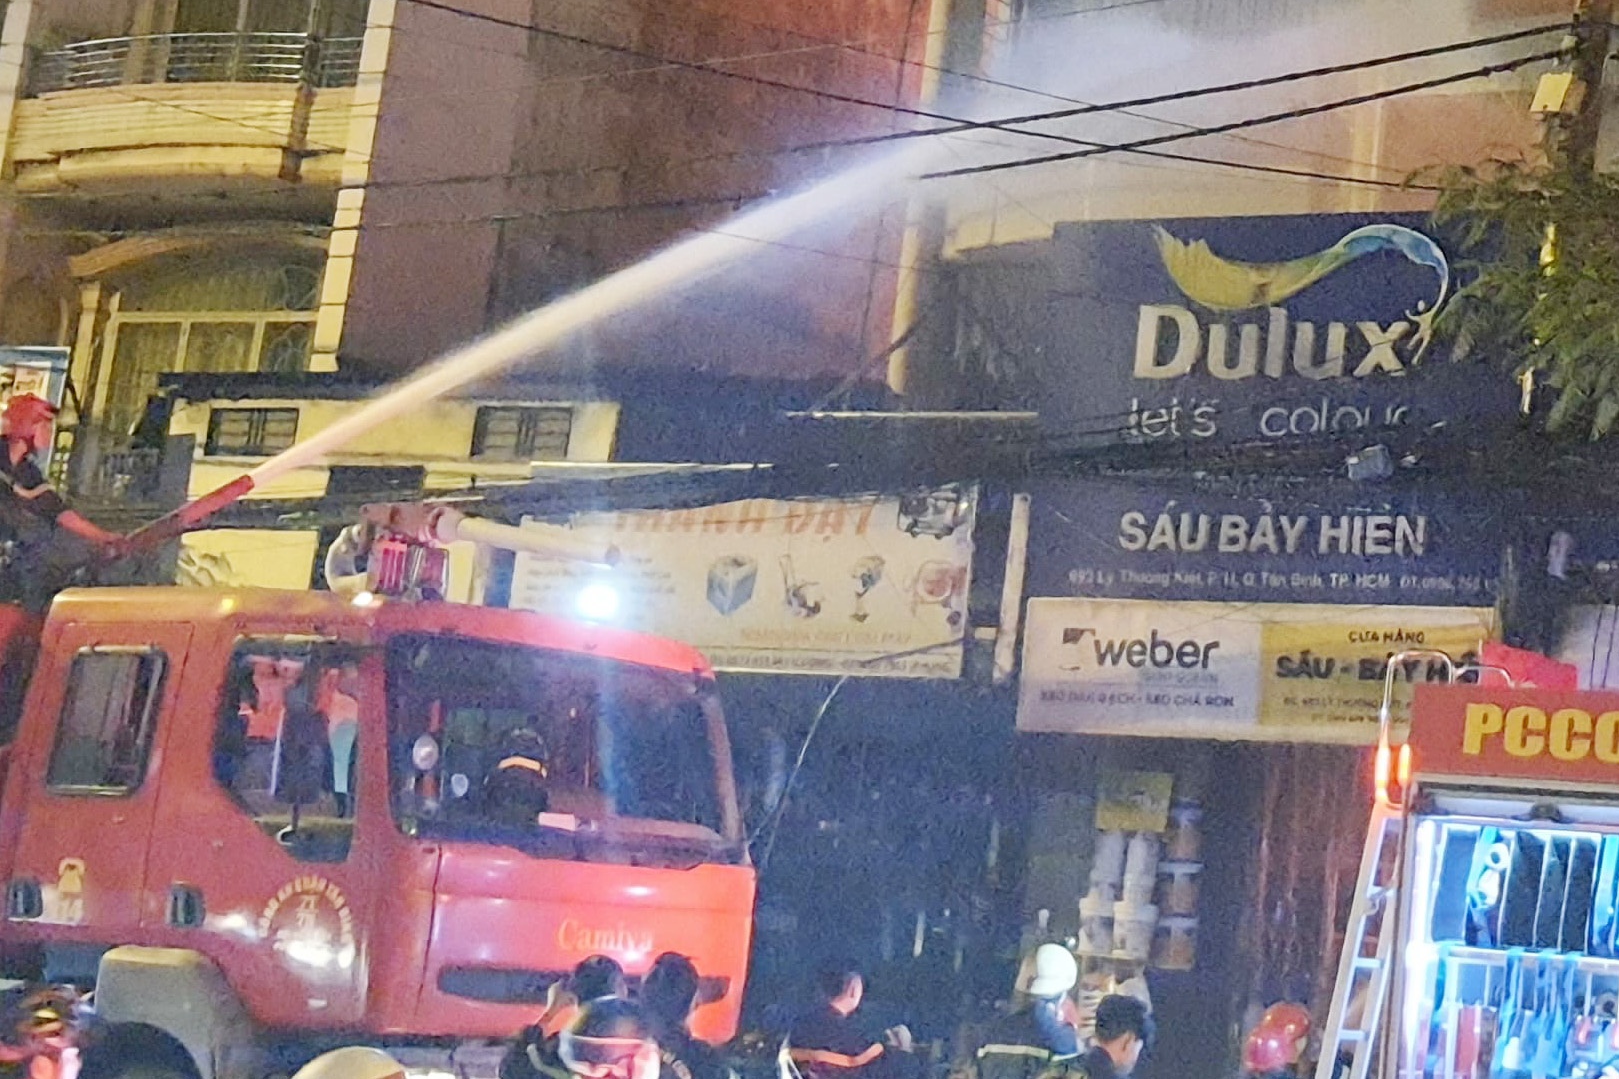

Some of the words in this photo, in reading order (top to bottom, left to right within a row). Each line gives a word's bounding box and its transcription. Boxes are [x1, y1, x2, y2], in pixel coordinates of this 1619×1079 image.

[1133, 304, 1411, 380] Dulux
[1118, 499, 1212, 552] SÁU
[1217, 499, 1309, 554] BẢY
[1094, 629, 1220, 669] weber
